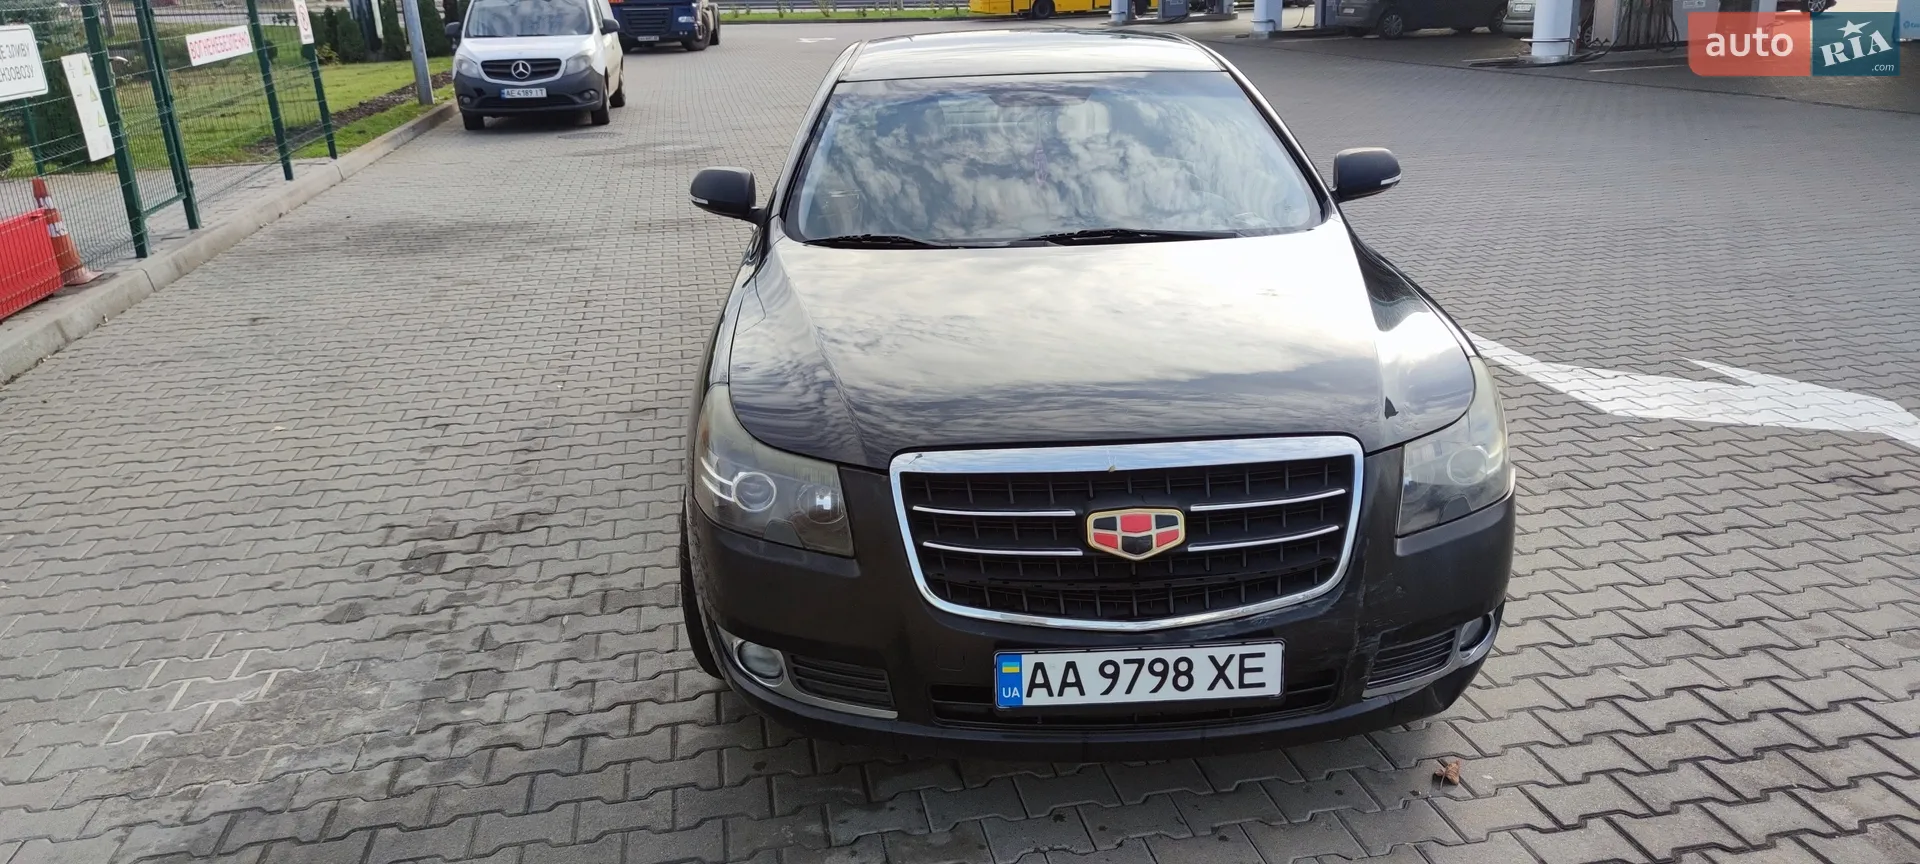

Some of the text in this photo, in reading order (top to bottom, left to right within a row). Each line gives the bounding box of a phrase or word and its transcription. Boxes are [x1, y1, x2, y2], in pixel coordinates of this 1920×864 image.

[6, 43, 30, 59] ЗЛИВУ
[1026, 652, 1266, 697] AA 9798 XE
[1002, 686, 1020, 698] UA
